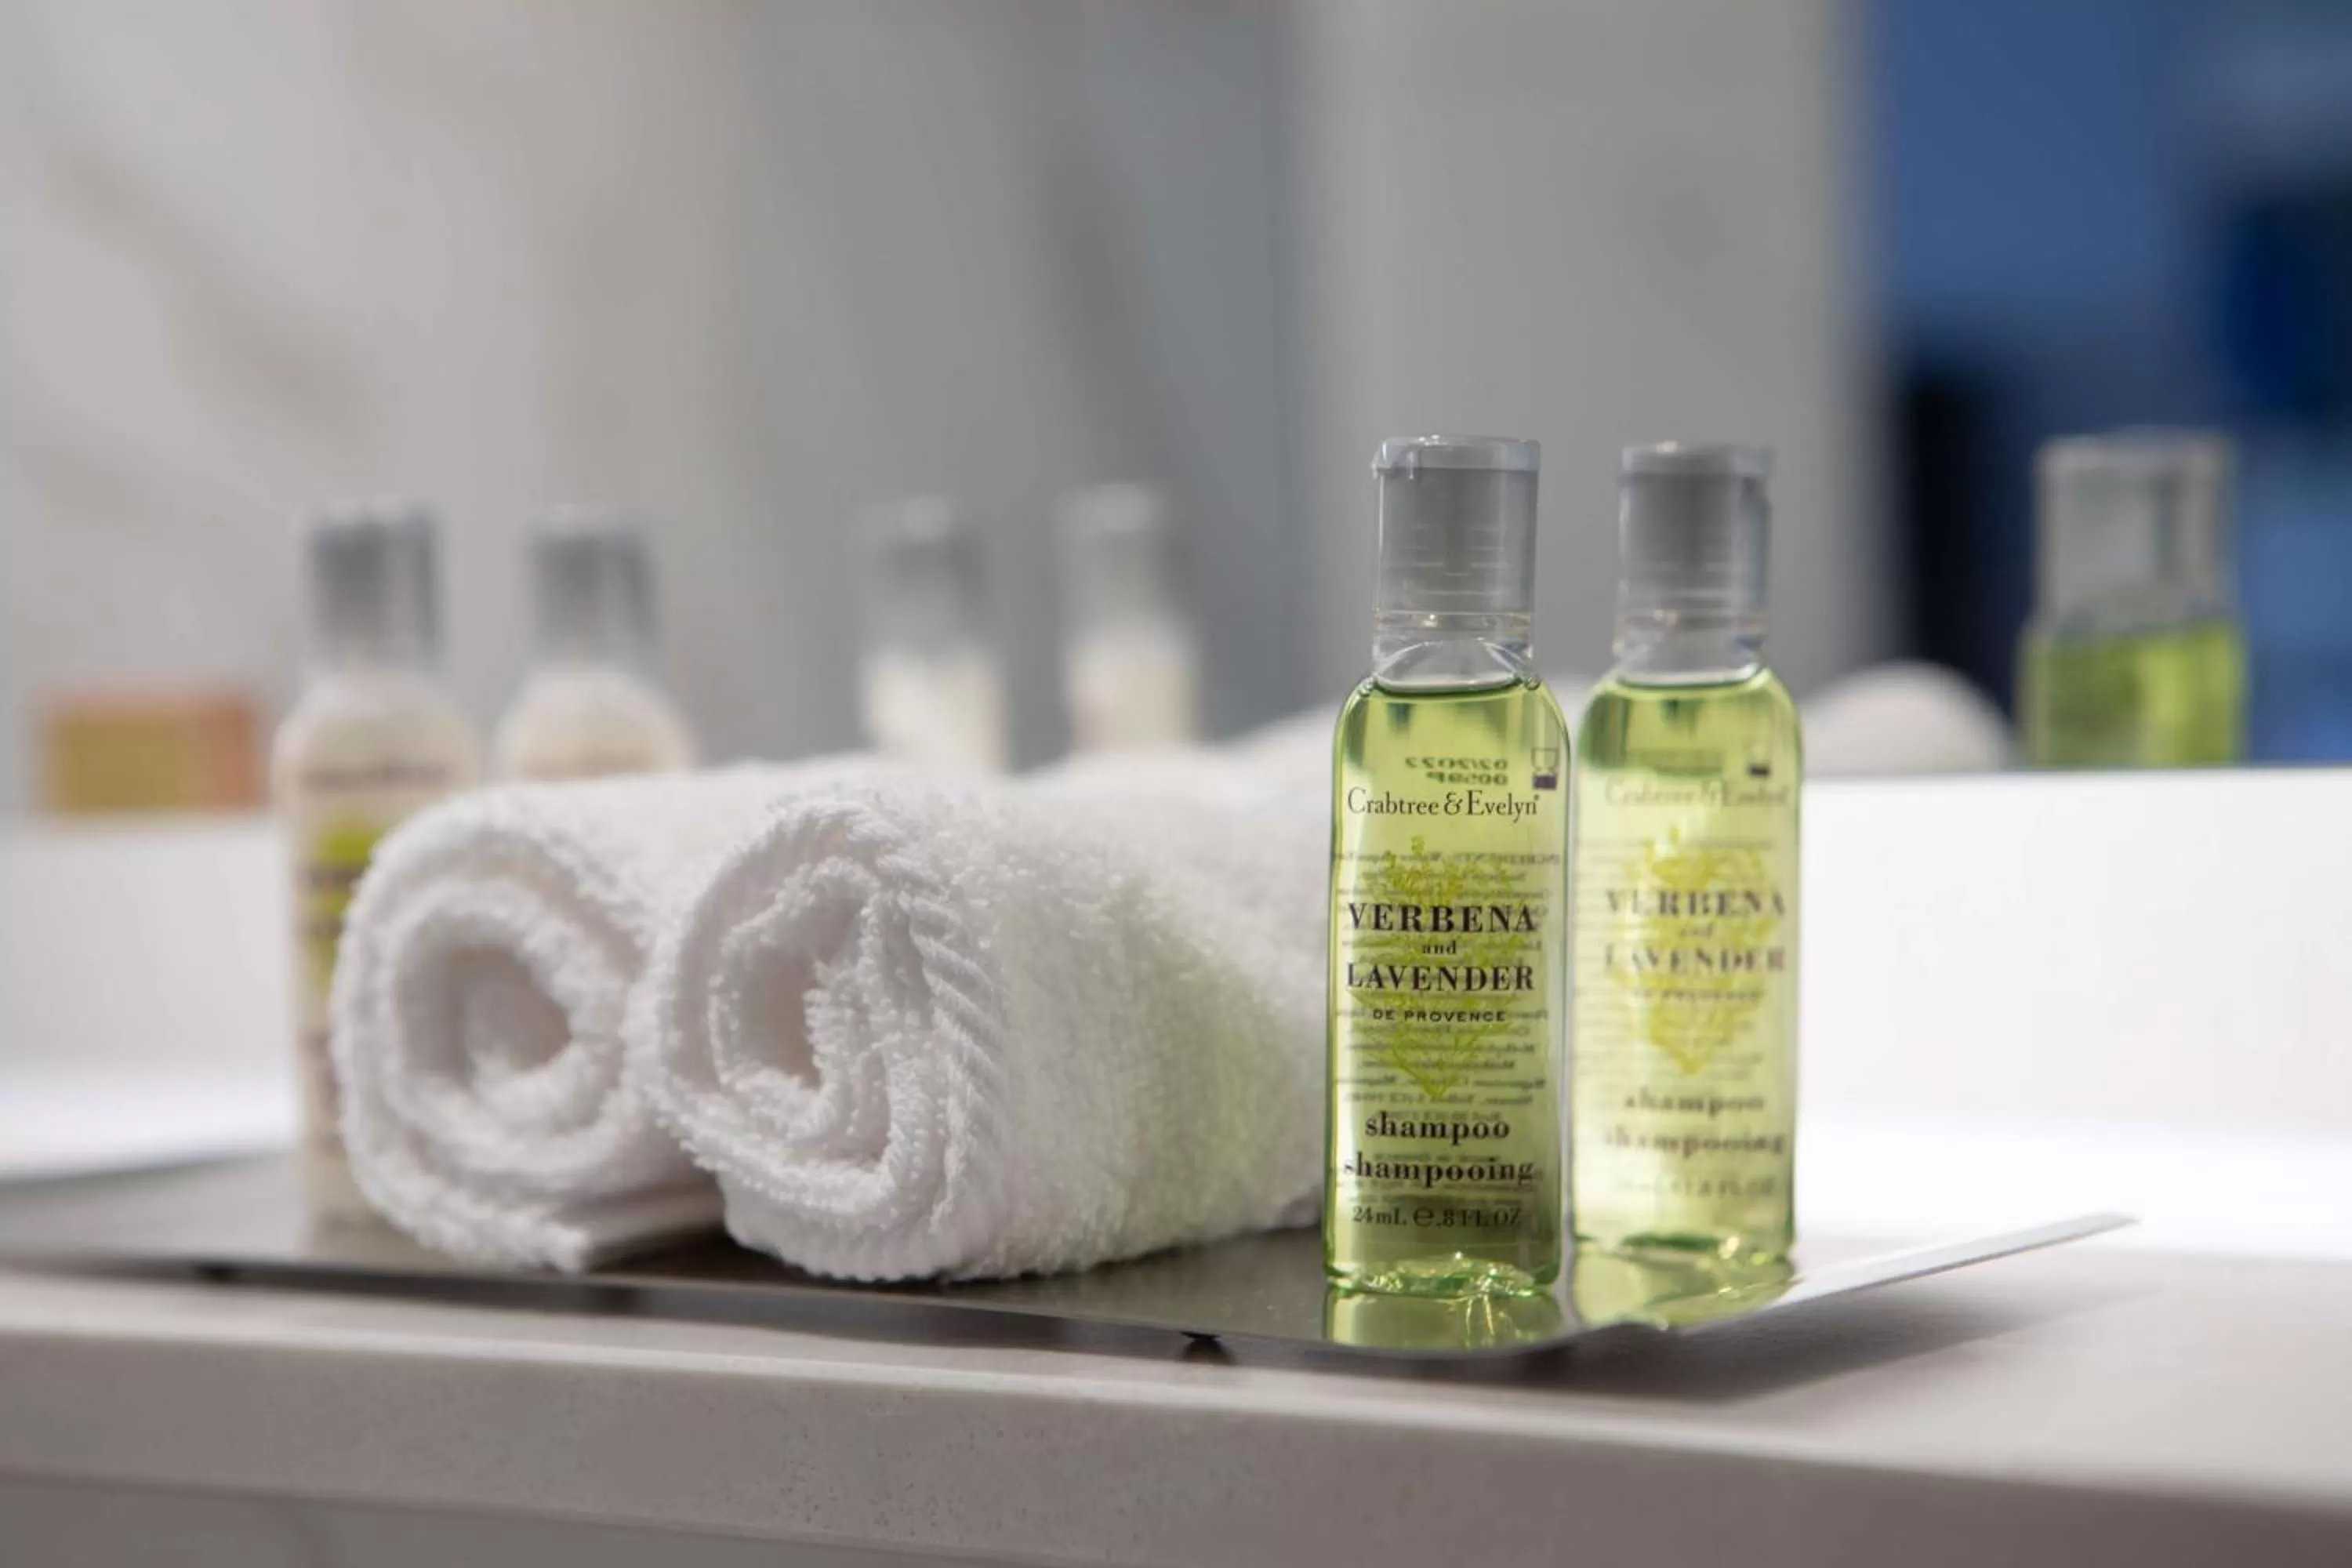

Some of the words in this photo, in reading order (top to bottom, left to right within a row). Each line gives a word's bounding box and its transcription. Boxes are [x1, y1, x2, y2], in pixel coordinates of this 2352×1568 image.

[1348, 786, 1439, 815] Crabtree
[1443, 791, 1464, 815] &
[1466, 789, 1538, 823] Evelyn
[1347, 902, 1538, 933] VERBENA
[1421, 940, 1457, 955] and
[1347, 963, 1534, 992] LAVENDER
[1373, 1008, 1399, 1021] DE
[1403, 1008, 1507, 1023] PROVENCE
[1364, 1109, 1511, 1146] shampoo
[1344, 1151, 1536, 1189] shampooing
